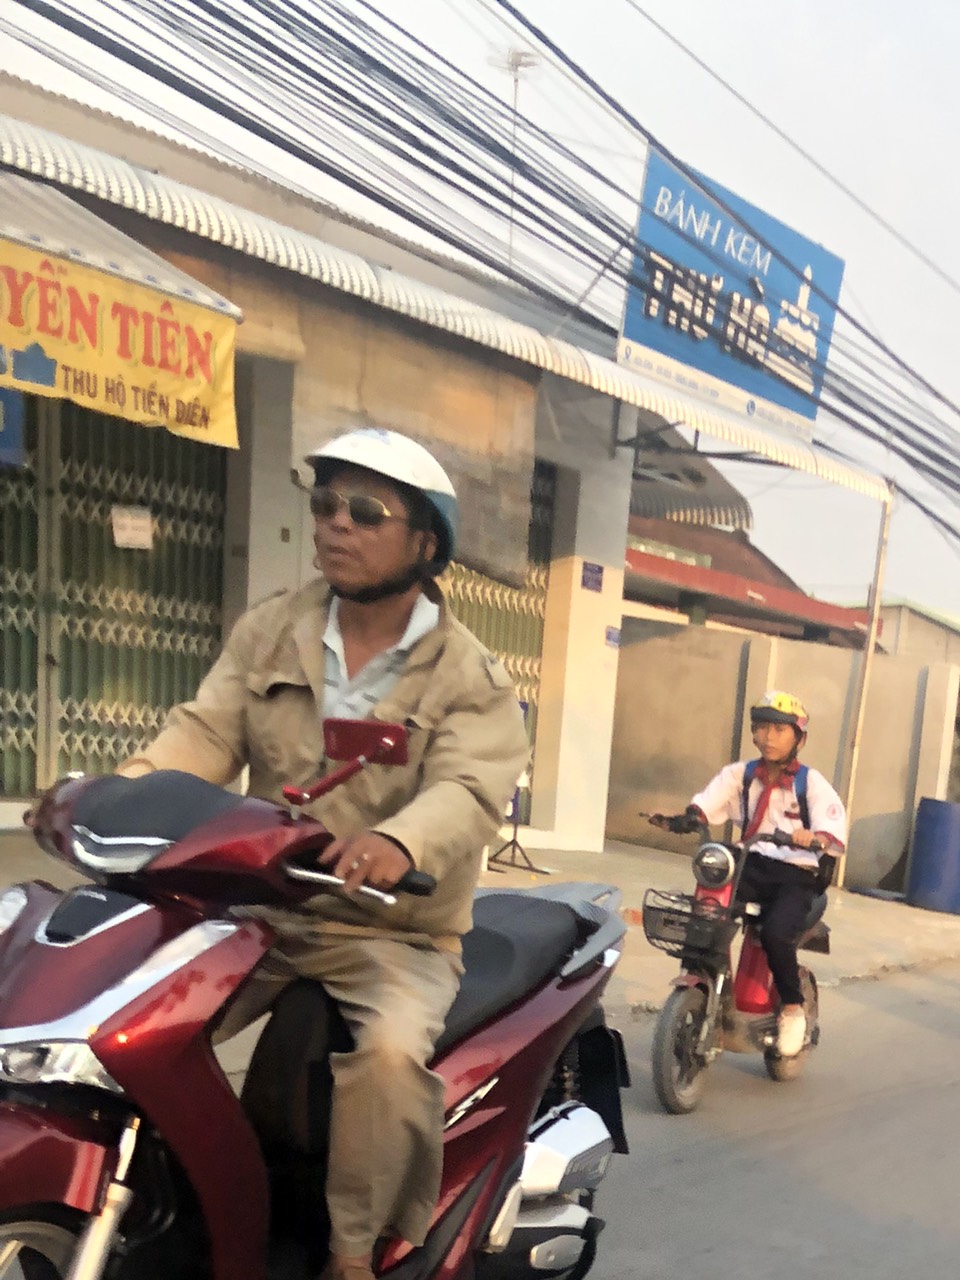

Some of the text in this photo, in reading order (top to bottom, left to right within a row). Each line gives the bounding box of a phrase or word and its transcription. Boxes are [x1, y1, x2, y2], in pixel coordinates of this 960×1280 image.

[654, 186, 772, 276] BÁNH KEM
[61, 364, 98, 399] THU
[105, 374, 127, 413] HỘ
